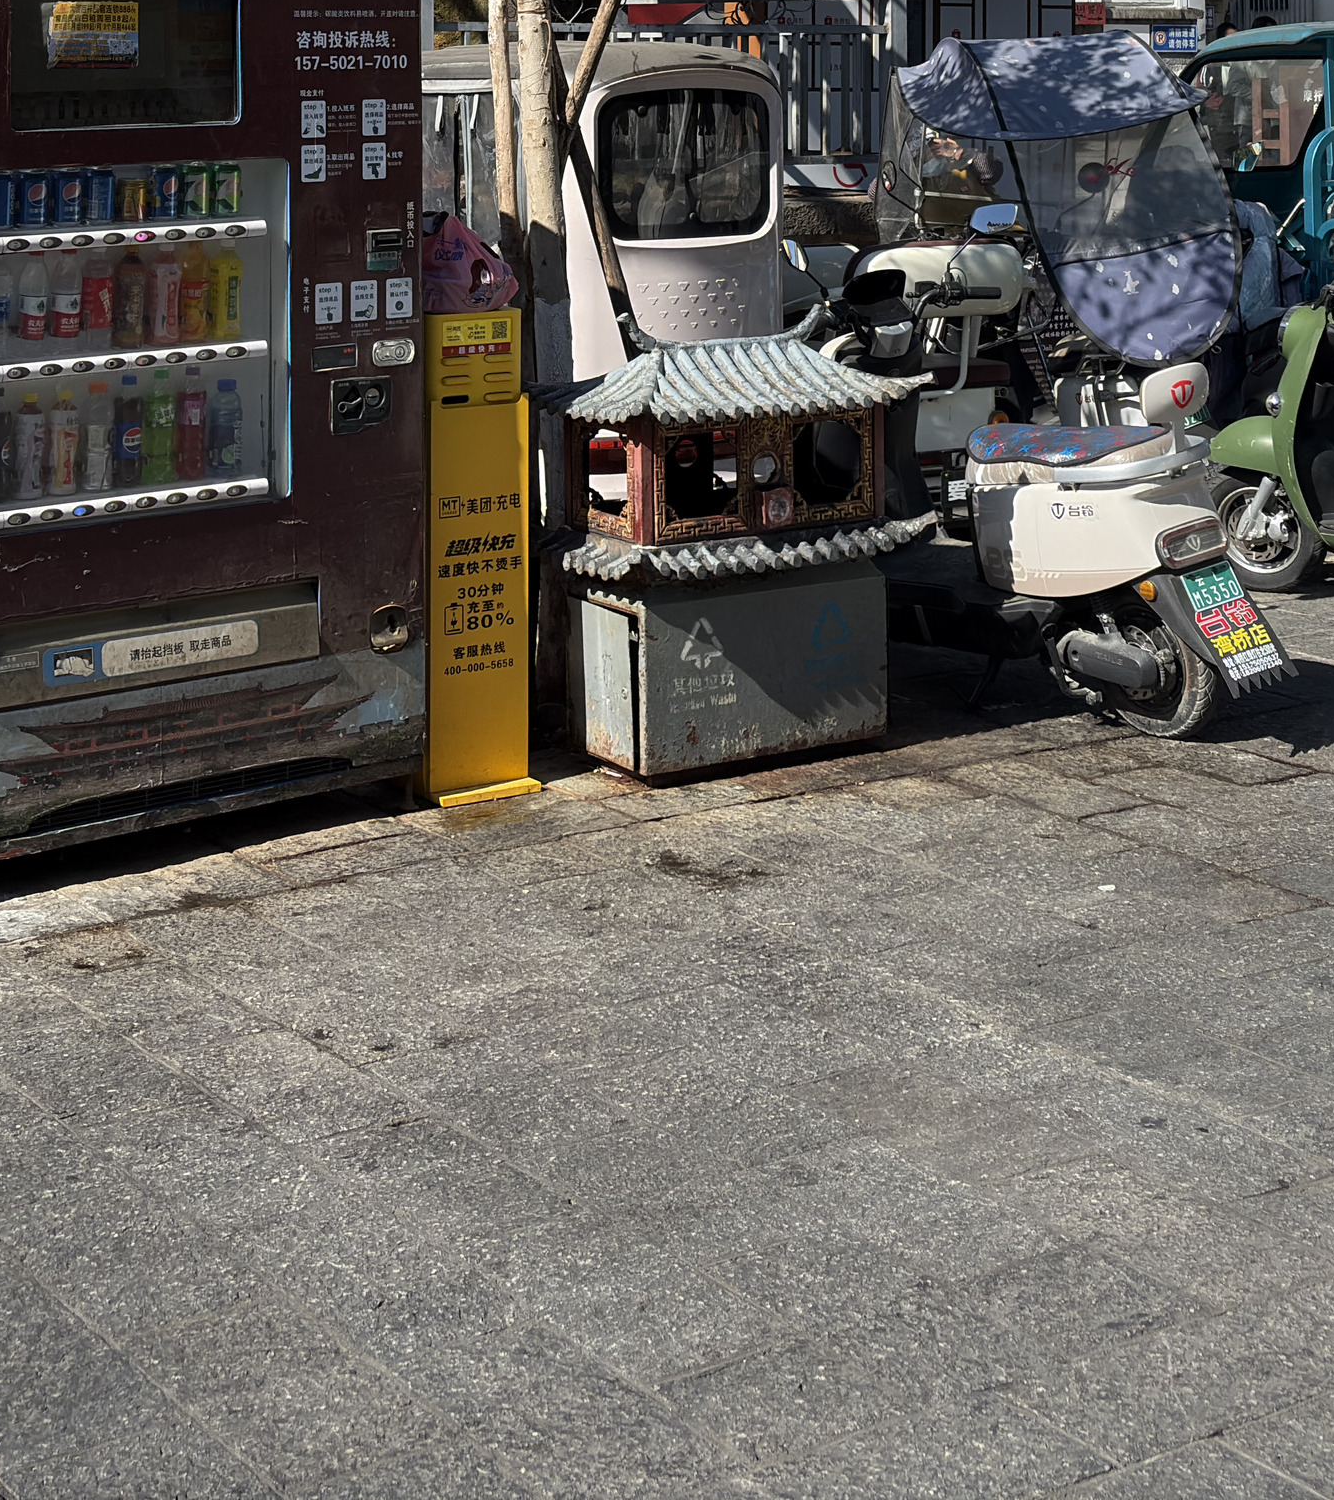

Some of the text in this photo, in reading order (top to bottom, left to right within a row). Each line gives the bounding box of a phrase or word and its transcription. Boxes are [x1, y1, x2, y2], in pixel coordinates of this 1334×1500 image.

[1168, 27, 1196, 38] 消防通道
[1168, 39, 1196, 49] 请勿停车
[294, 54, 408, 71] 157-5021-7010
[299, 89, 324, 97] 现金支付
[406, 201, 415, 248] 纸币投入口
[458, 344, 496, 355] 超级快充
[442, 499, 458, 511] MT
[445, 533, 516, 557] 超级快充
[438, 555, 522, 579] 速度快不烫手
[457, 582, 504, 600] 30分钟
[1192, 580, 1239, 609] M5350
[467, 610, 515, 631] 80%
[129, 634, 232, 662] 请抬起挡板 取走商品
[1210, 623, 1272, 657] 湾桥店
[453, 641, 506, 660] 客服热线
[444, 658, 514, 677] 400-000-5658
